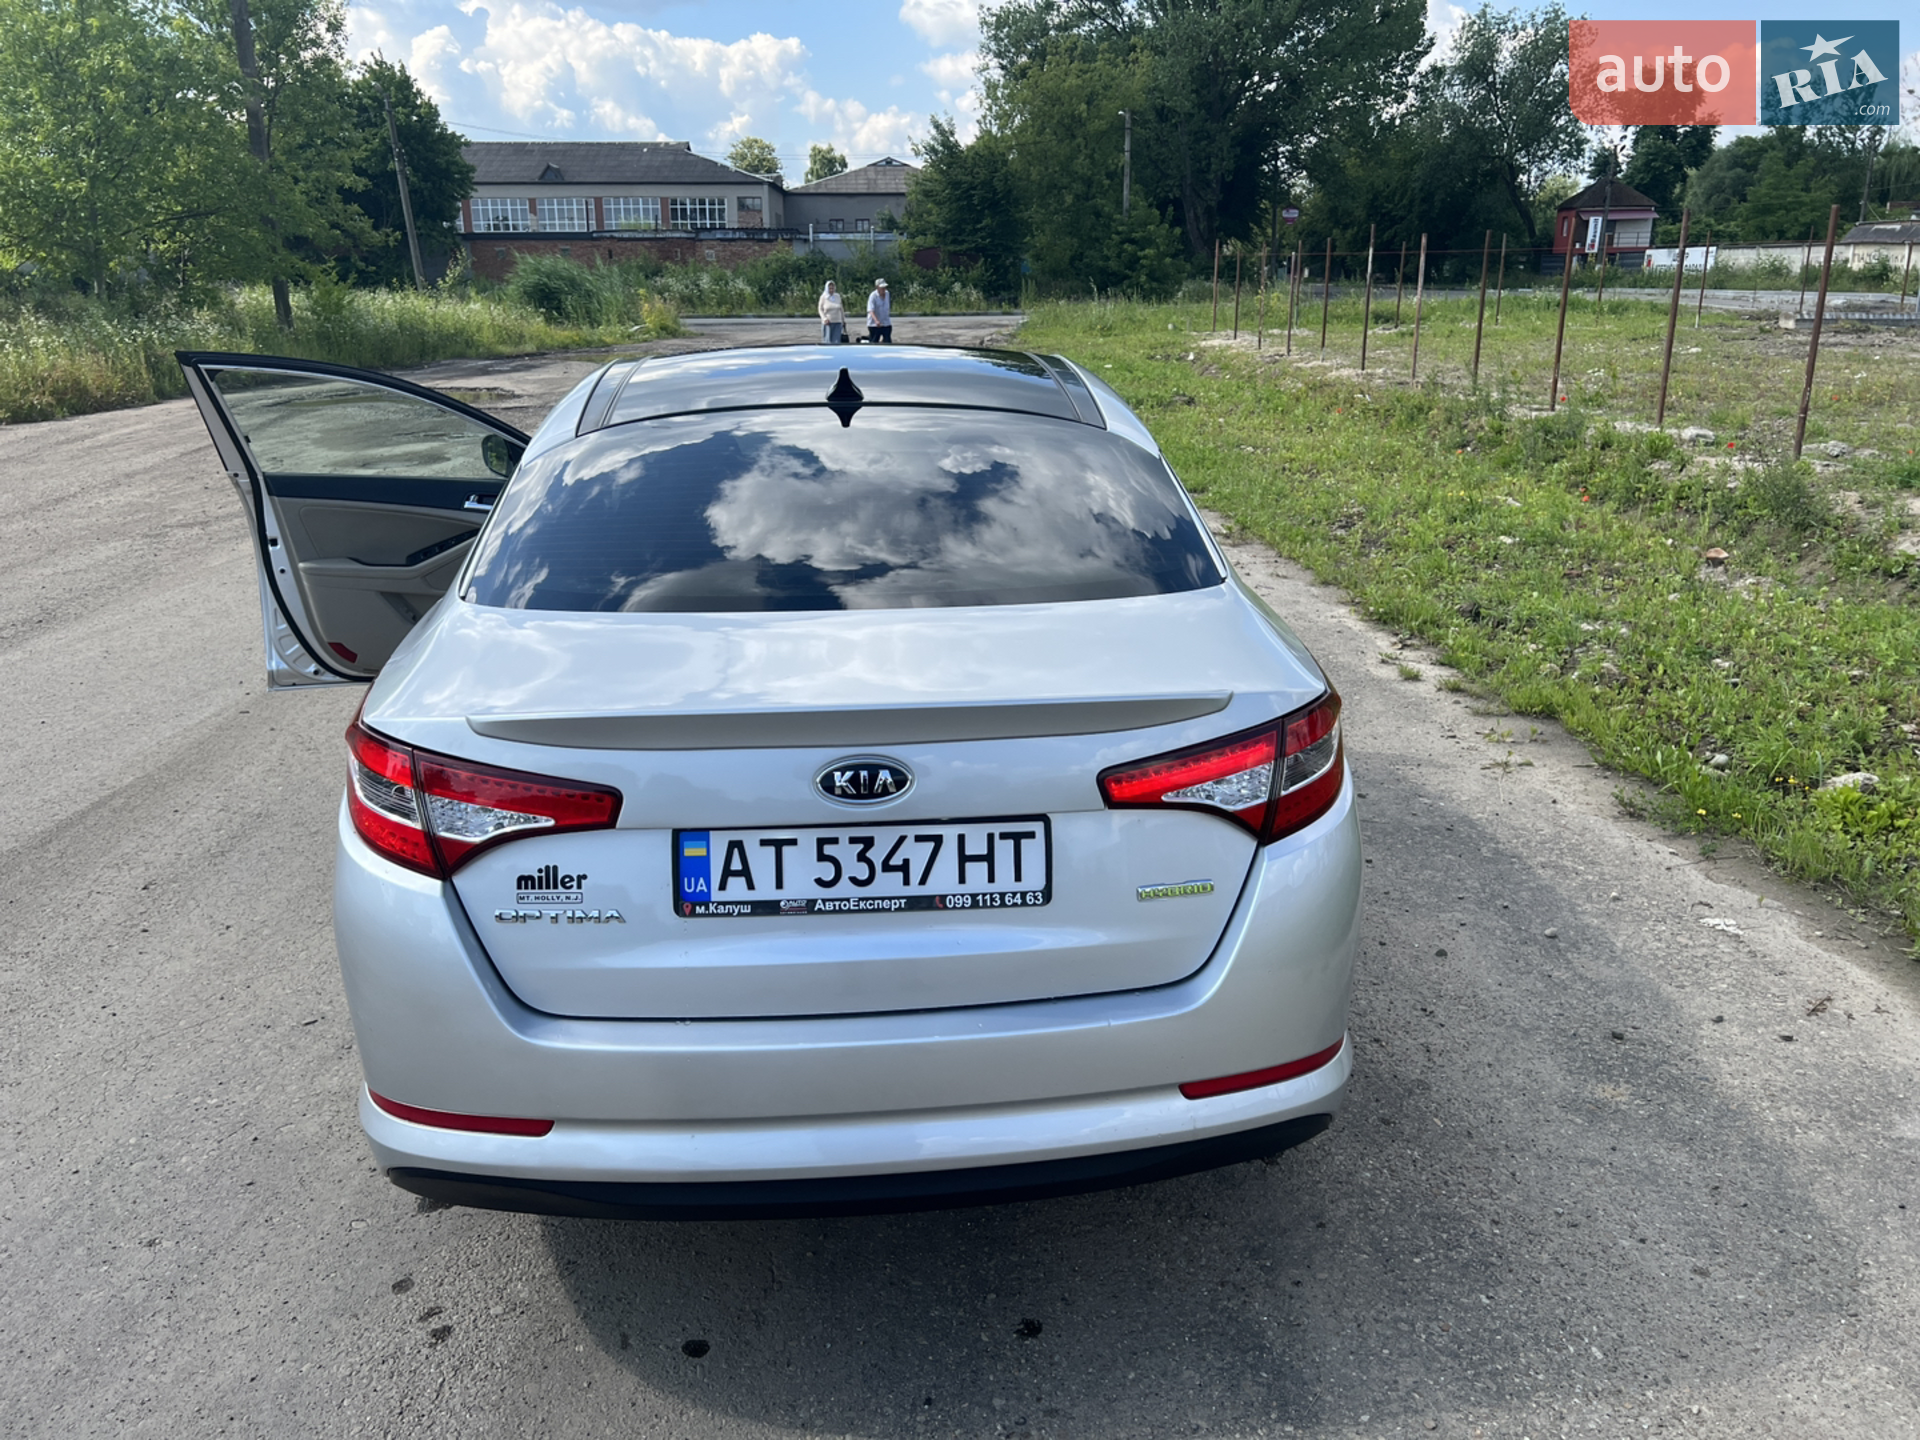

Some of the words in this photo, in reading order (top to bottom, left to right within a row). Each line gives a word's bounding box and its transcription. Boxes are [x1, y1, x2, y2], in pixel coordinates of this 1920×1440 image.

[832, 768, 898, 796] KIA
[717, 838, 798, 892] AT
[812, 833, 944, 889] 5347
[957, 830, 1037, 885] HT
[516, 864, 588, 890] miller
[684, 877, 708, 894] UA
[1139, 881, 1213, 900] HYBRID
[813, 898, 907, 912] АвтоЕксперт
[945, 894, 972, 909] 099
[976, 893, 1001, 907] 113
[1004, 892, 1022, 906] 64
[1026, 891, 1043, 905] 63
[494, 908, 627, 924] OPTIMA
[695, 903, 751, 916] м.Калуш
